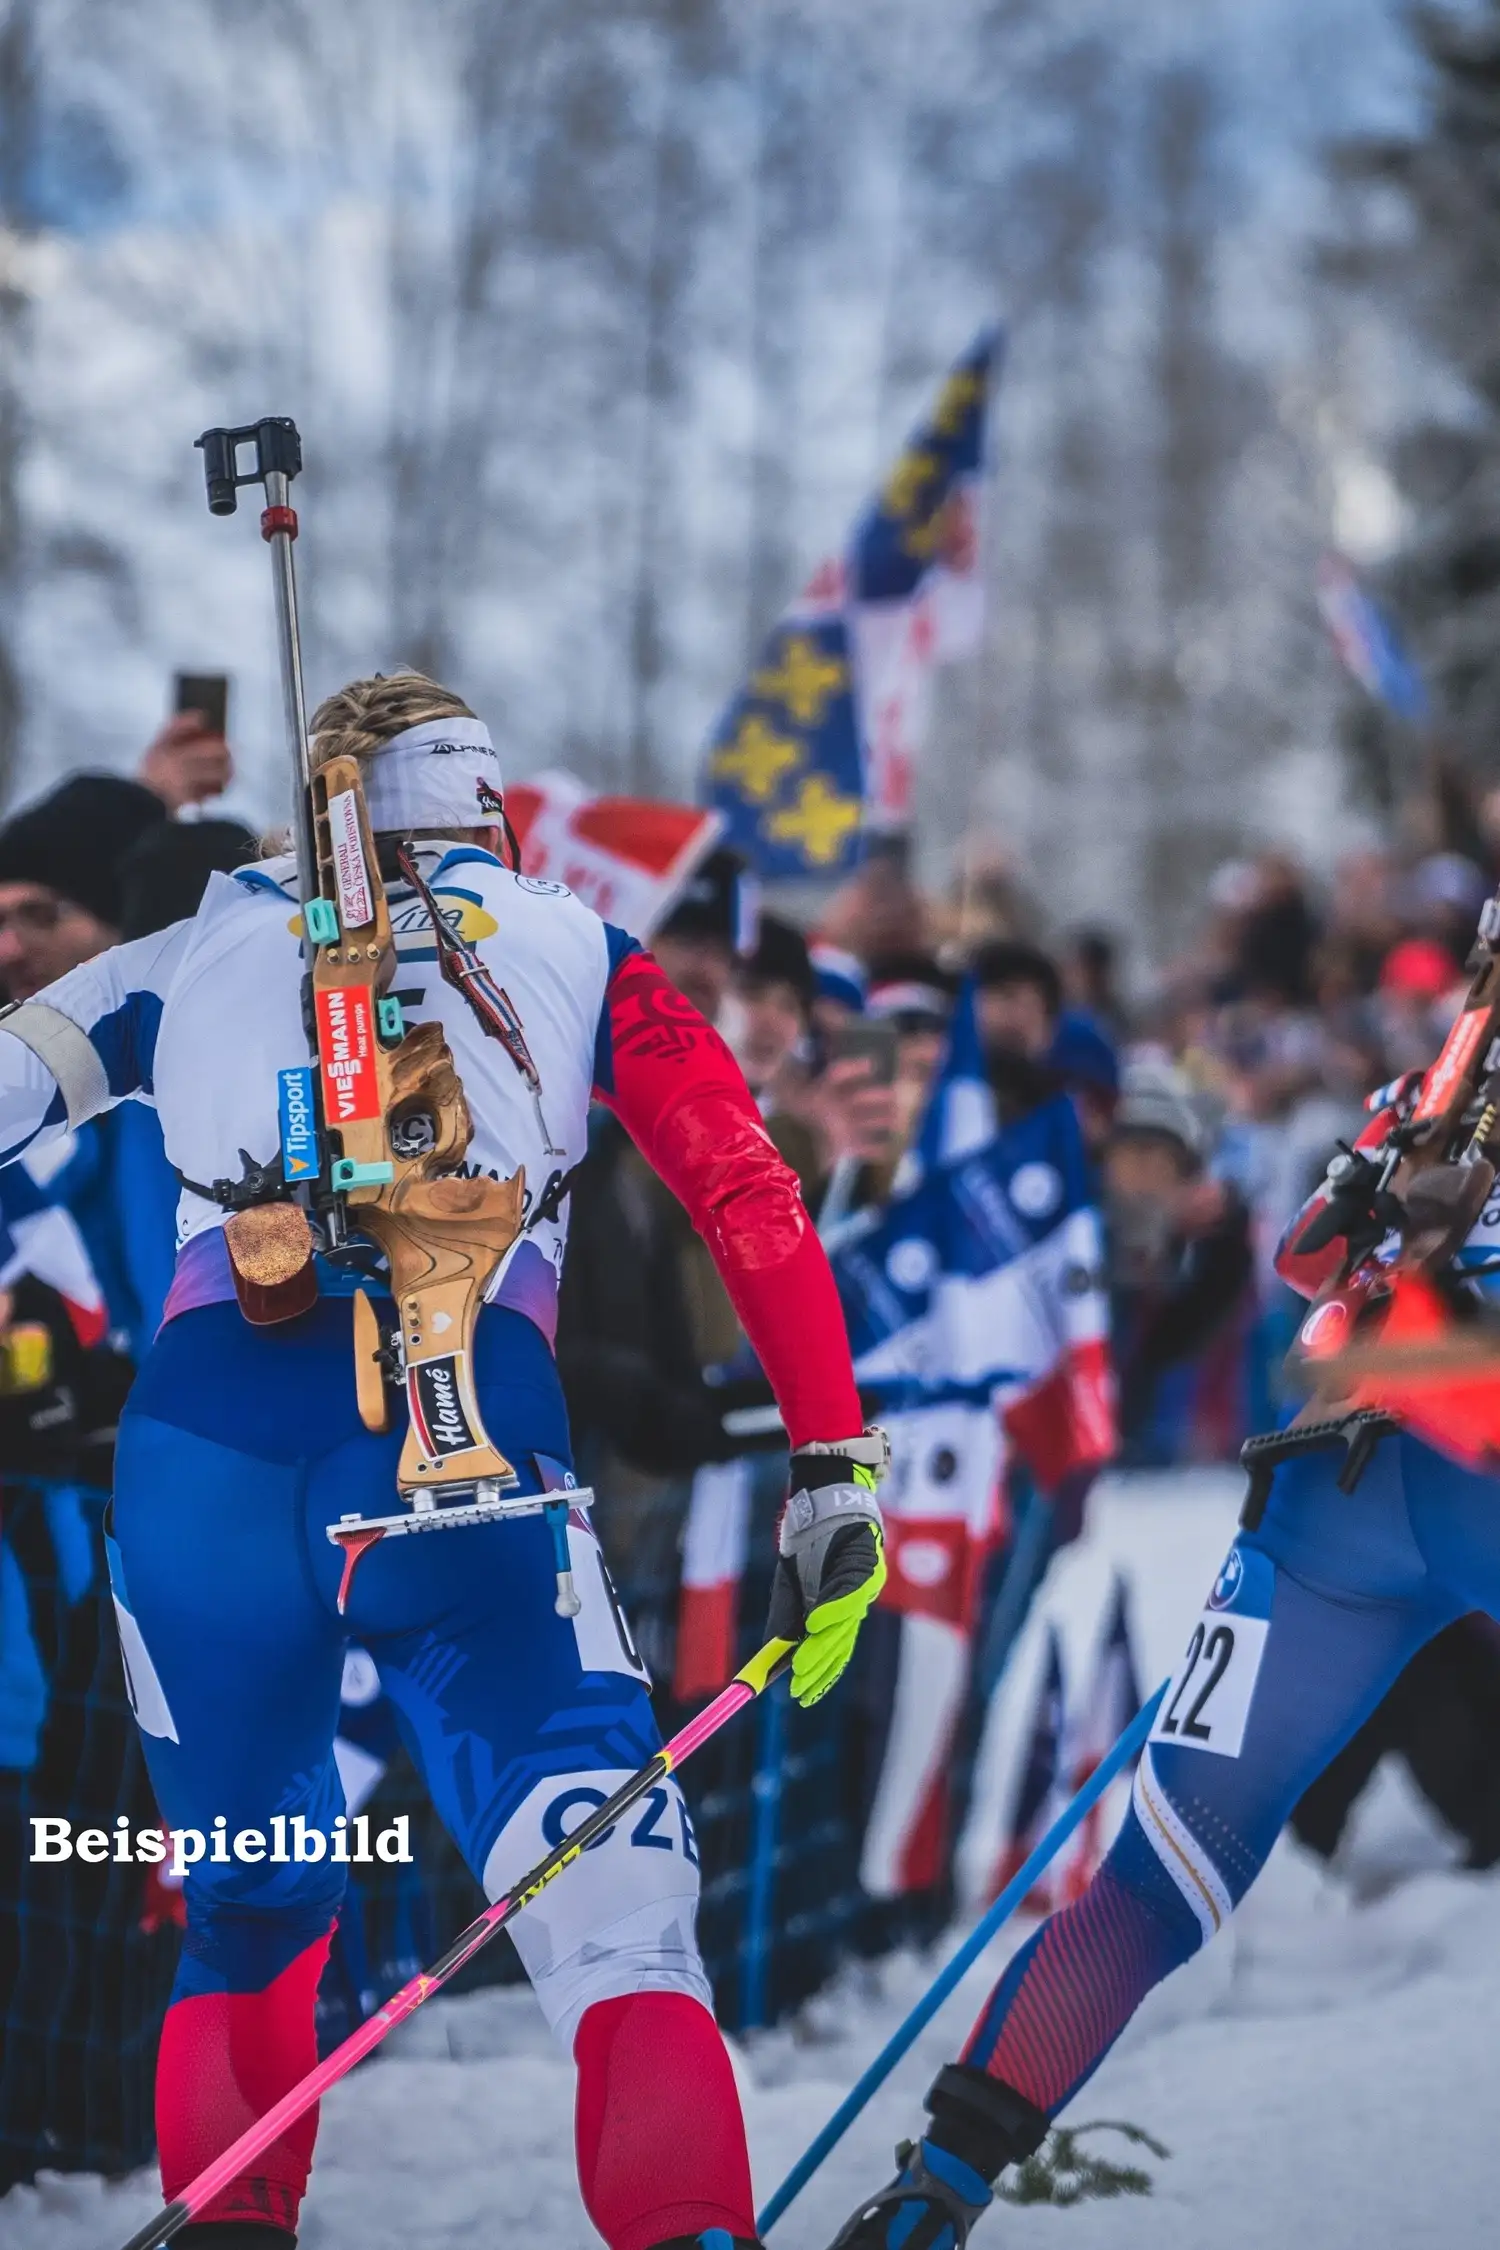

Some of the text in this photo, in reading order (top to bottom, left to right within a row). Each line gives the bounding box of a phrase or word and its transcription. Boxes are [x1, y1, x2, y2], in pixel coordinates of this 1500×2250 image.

[338, 843, 352, 890] GENERALI
[328, 991, 362, 1119] VIESSMANN
[355, 1003, 369, 1058] Heat pumps
[283, 1072, 310, 1153] Tipsport
[426, 1367, 467, 1446] Hamé
[1161, 1621, 1235, 1741] 22
